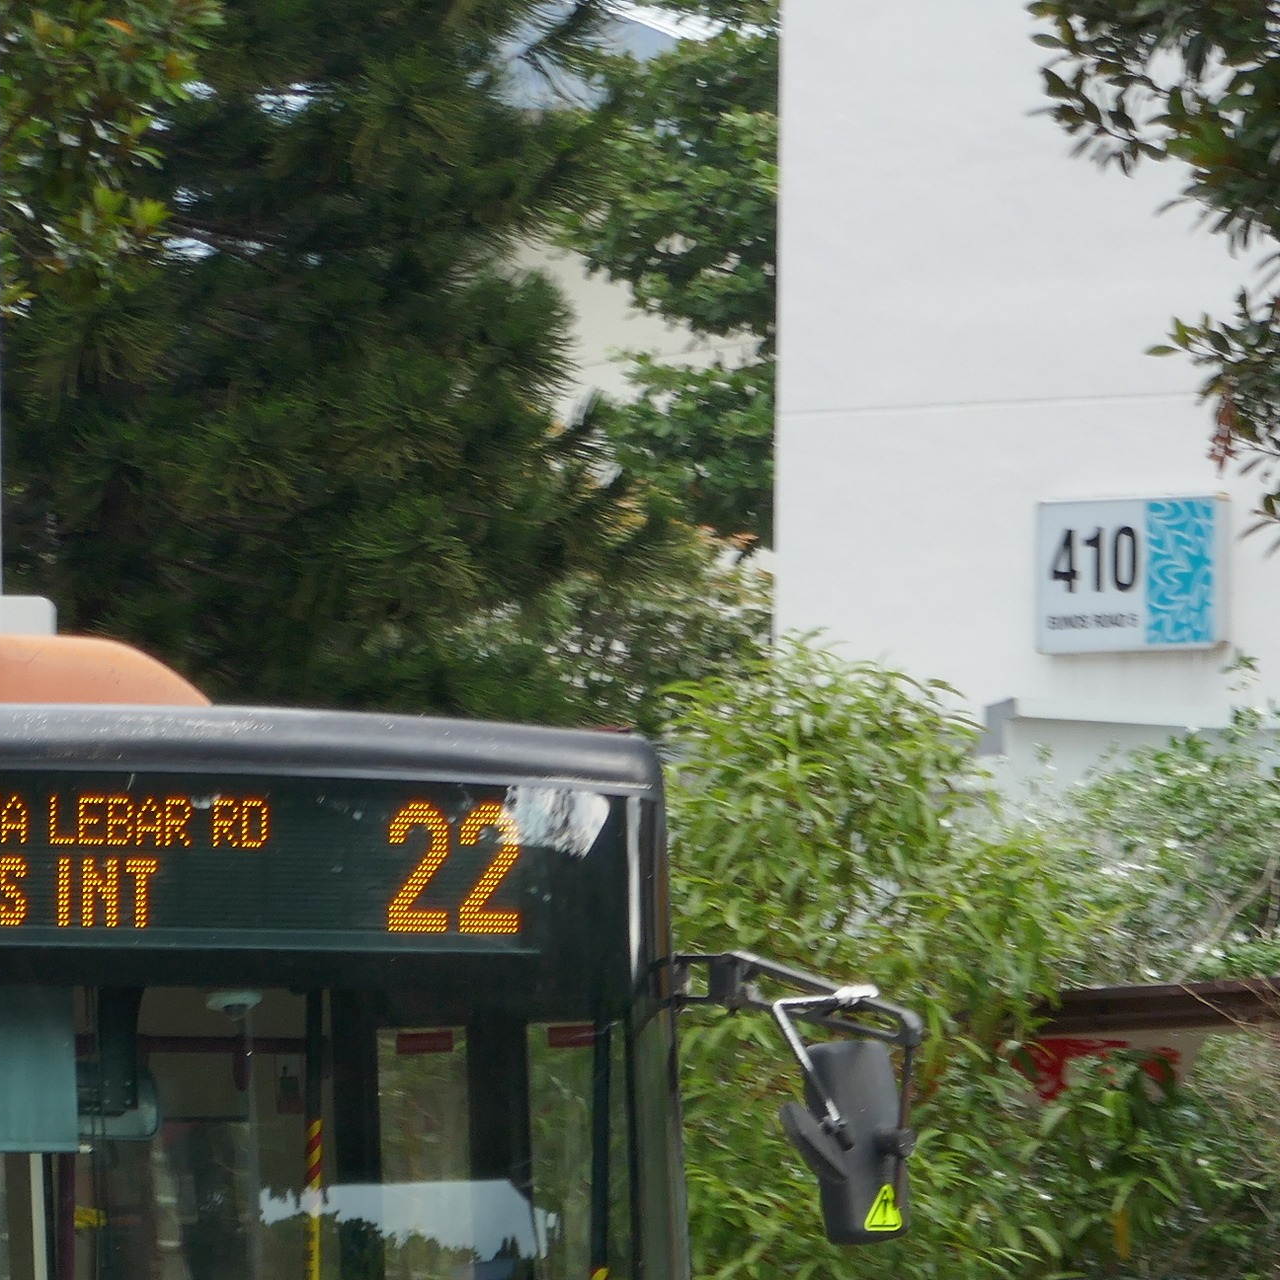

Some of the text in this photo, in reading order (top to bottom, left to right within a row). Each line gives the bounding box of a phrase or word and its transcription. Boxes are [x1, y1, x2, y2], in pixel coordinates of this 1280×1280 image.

[1051, 526, 1136, 593] 410
[48, 796, 192, 847] LEBAR
[211, 799, 269, 849] RD
[56, 857, 158, 928] INT
[386, 801, 520, 934] 22
